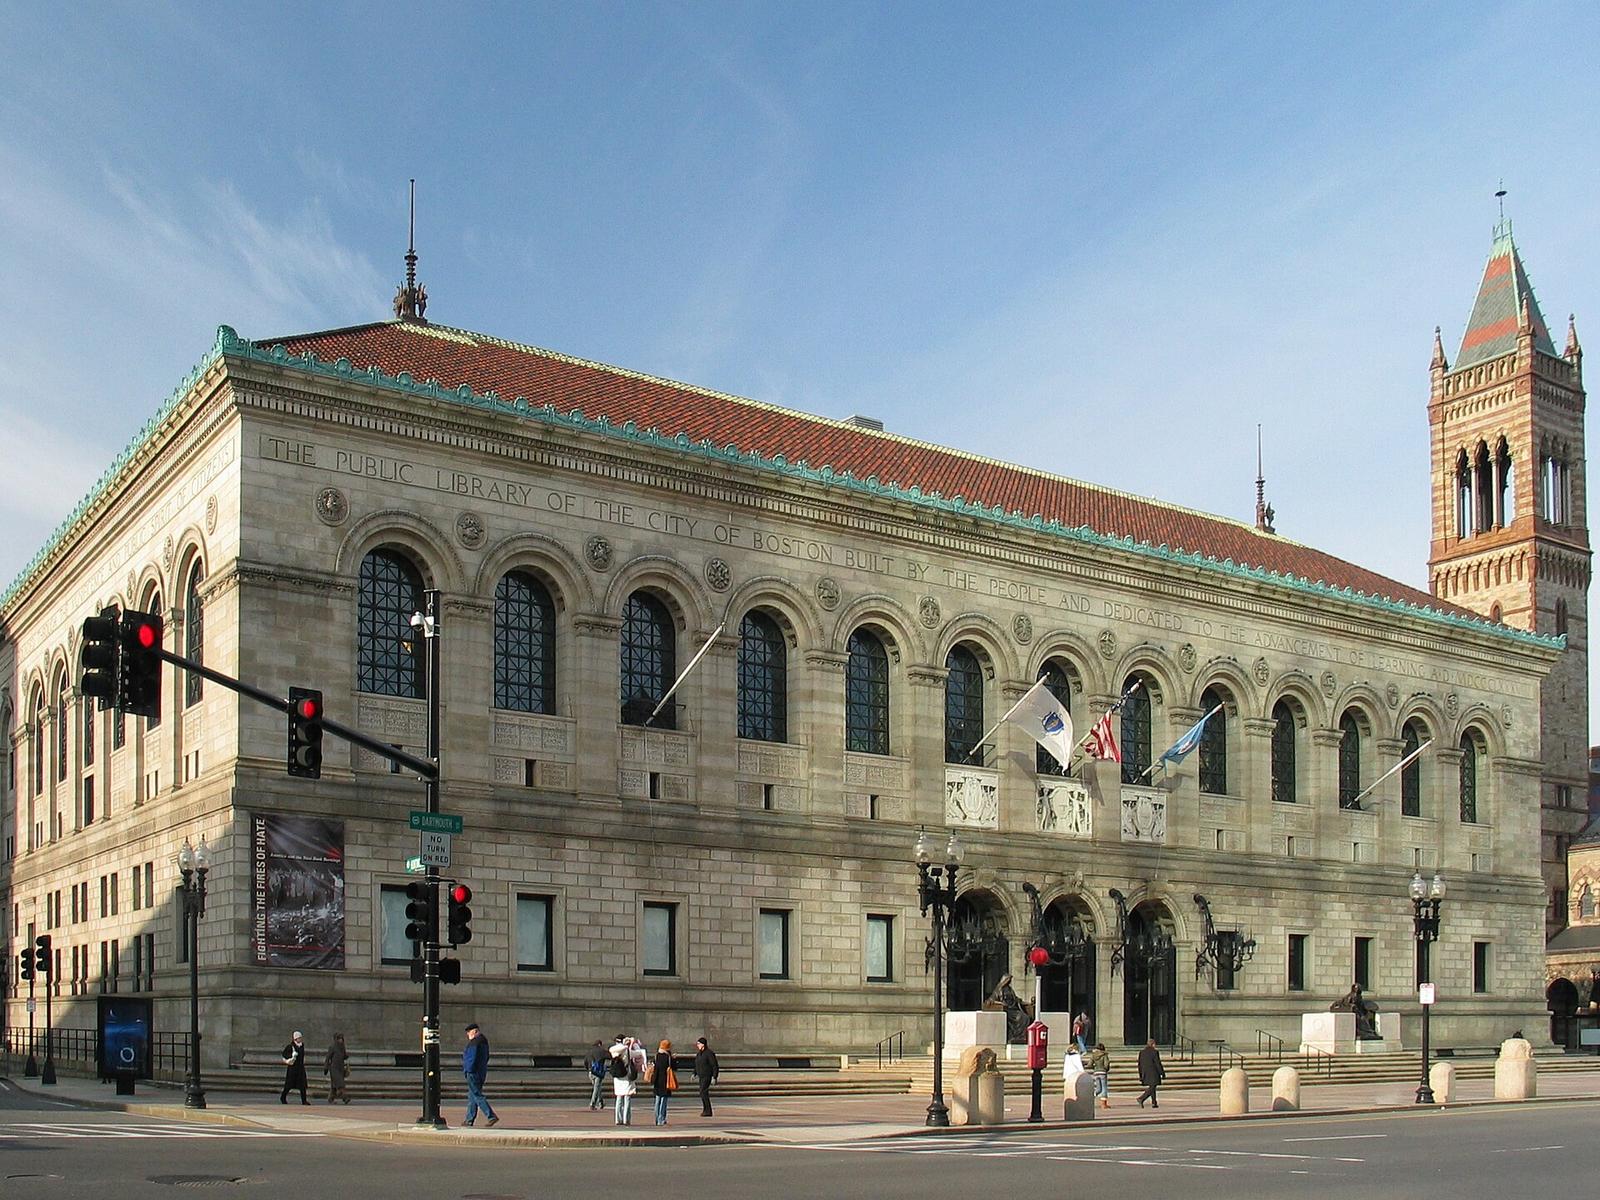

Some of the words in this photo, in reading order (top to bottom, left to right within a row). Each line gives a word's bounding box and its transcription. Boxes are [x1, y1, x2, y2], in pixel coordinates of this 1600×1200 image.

[268, 437, 317, 466] THE
[335, 451, 413, 484] PUBLIC
[436, 469, 532, 505] LIBRARY
[547, 491, 576, 513] OF
[594, 500, 634, 526] THE
[648, 512, 698, 537] CITY
[713, 524, 740, 545] OF
[753, 532, 833, 562] BOSTON
[845, 550, 894, 573] BUILT
[907, 562, 930, 580] BY
[943, 568, 978, 592] THE
[989, 578, 1048, 605] PEOPLE
[1059, 593, 1091, 613] AND
[1104, 601, 1183, 632] DEDICATED
[1194, 619, 1213, 636] TO
[1220, 625, 1248, 644] THE
[1254, 631, 1340, 662] ADVANCEMENT
[1350, 650, 1365, 664] OF
[1372, 653, 1426, 677] LEARNING
[421, 815, 453, 829] DARTMOUTH
[255, 818, 266, 846] HATE
[430, 835, 442, 844] NO
[256, 846, 266, 860] OF
[427, 845, 447, 853] TURN
[422, 853, 433, 862] ON
[435, 855, 449, 864] RED
[256, 860, 266, 890] FIRES
[256, 890, 266, 911] THE
[255, 912, 267, 961] FIGHTING
